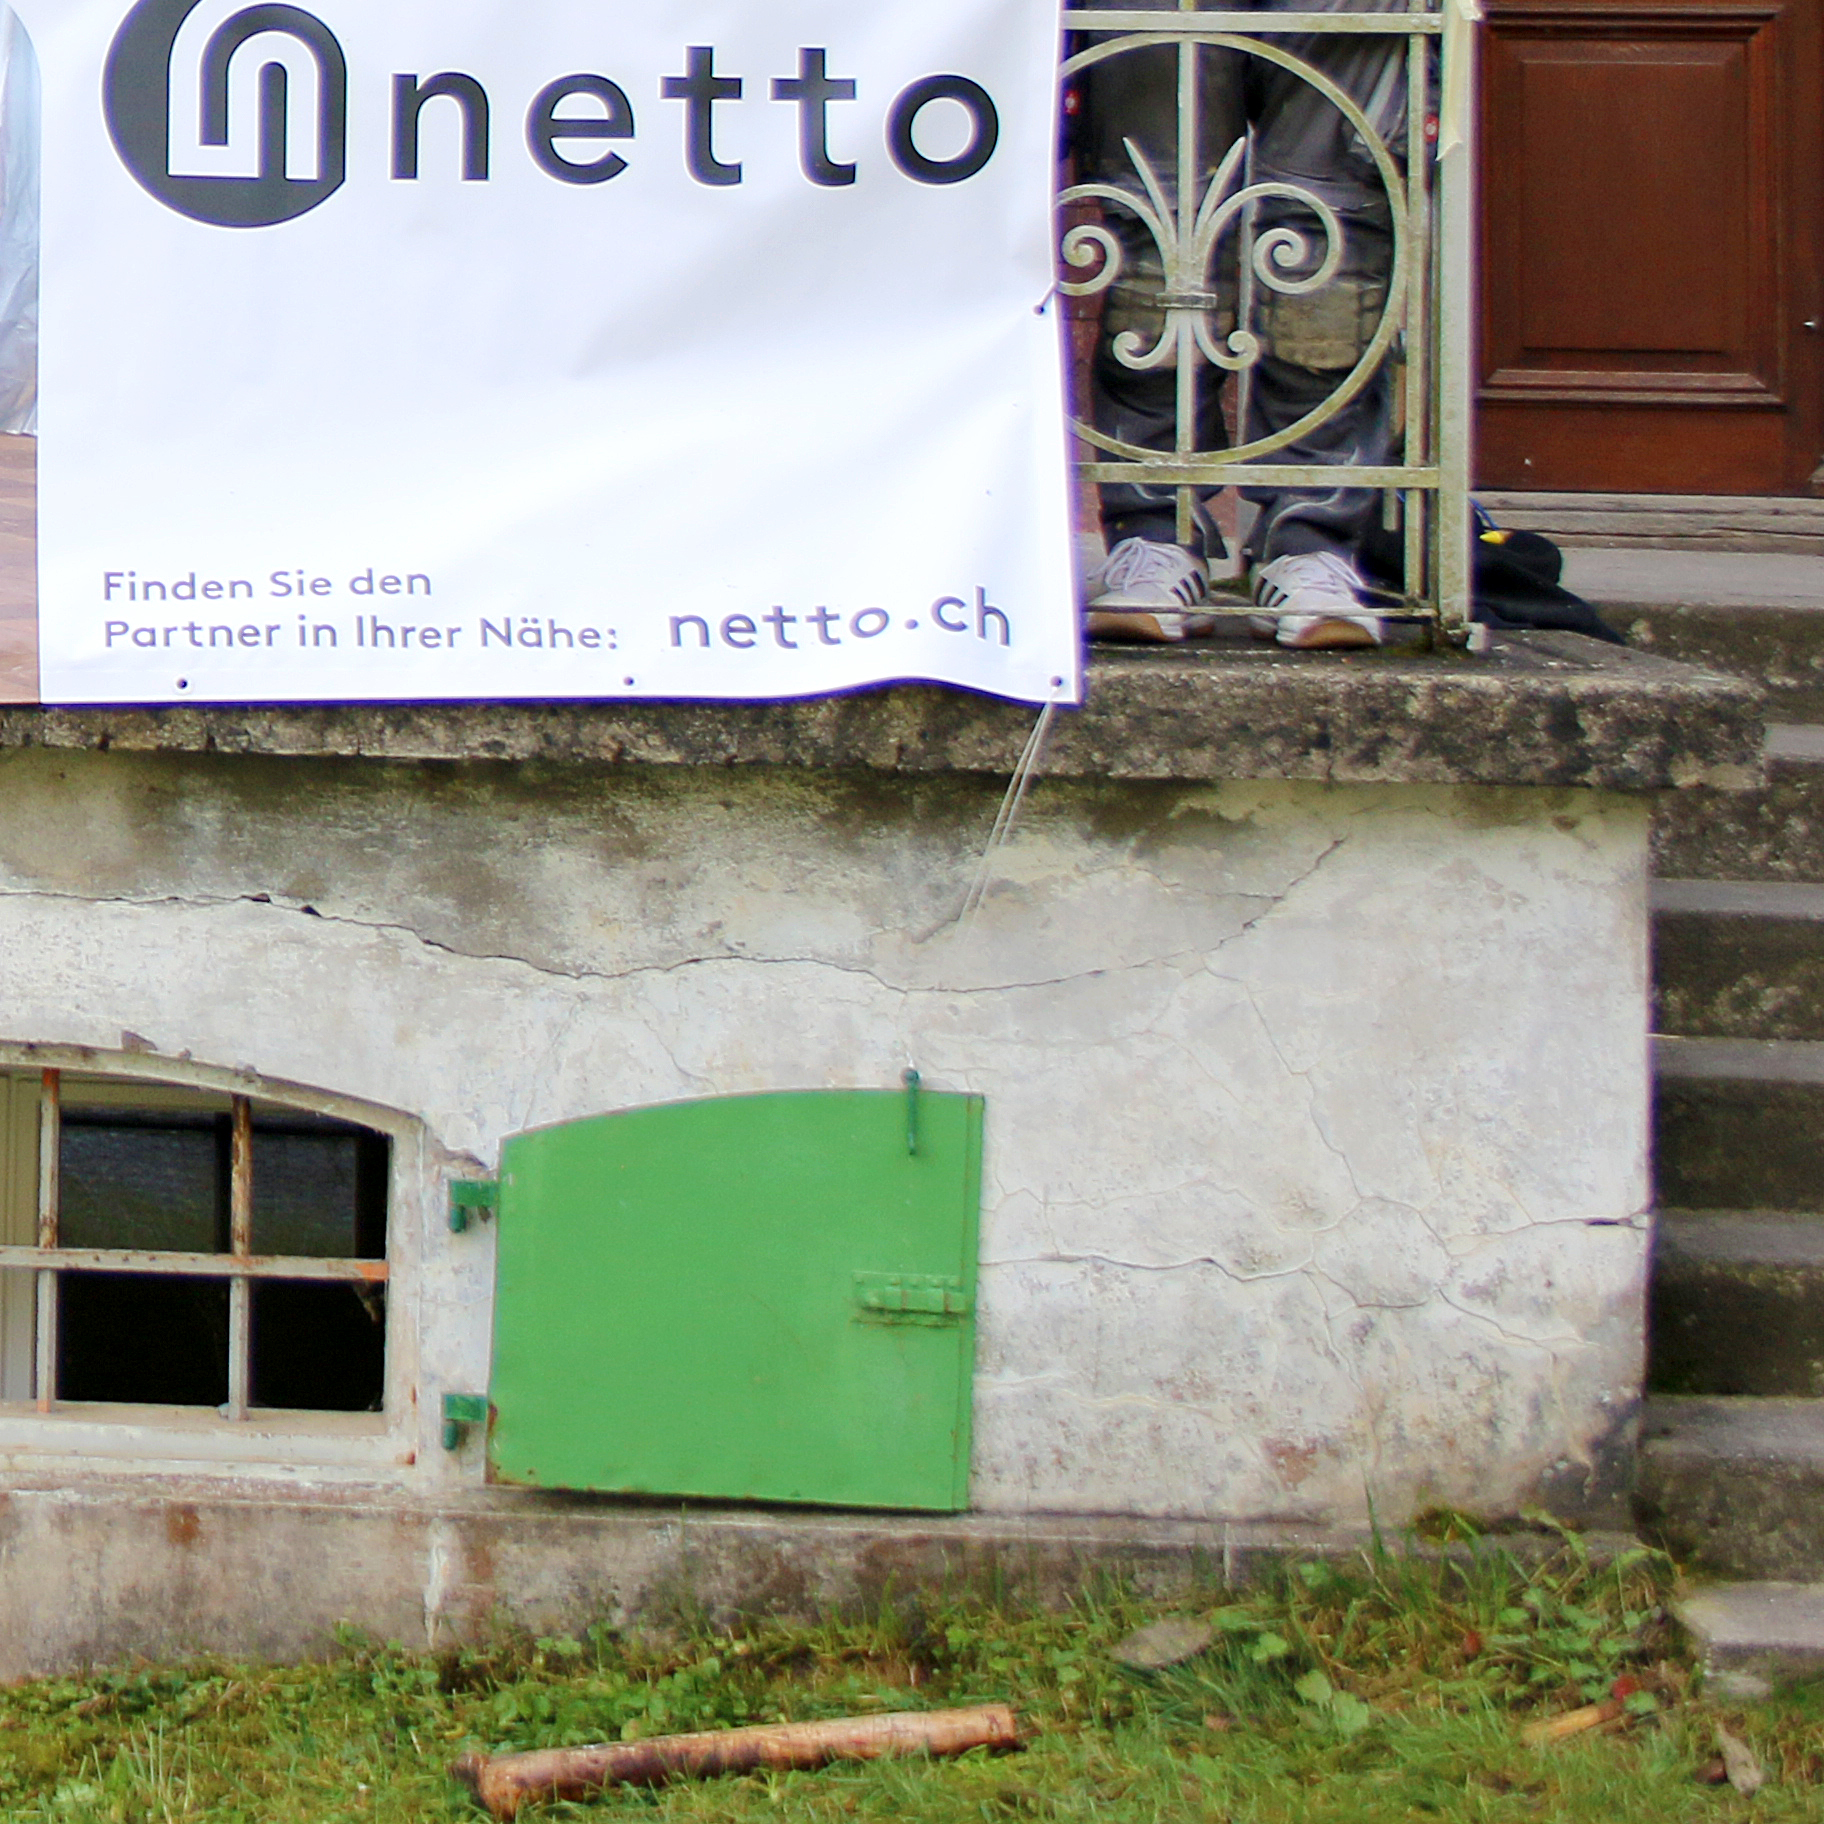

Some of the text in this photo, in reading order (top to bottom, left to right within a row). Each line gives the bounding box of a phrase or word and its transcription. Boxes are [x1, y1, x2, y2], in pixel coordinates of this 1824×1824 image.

[390, 44, 1002, 189] netto
[103, 567, 432, 602] Finden Sie den
[104, 585, 1012, 651] Partner in Ihrer Nähe: netto.ch
